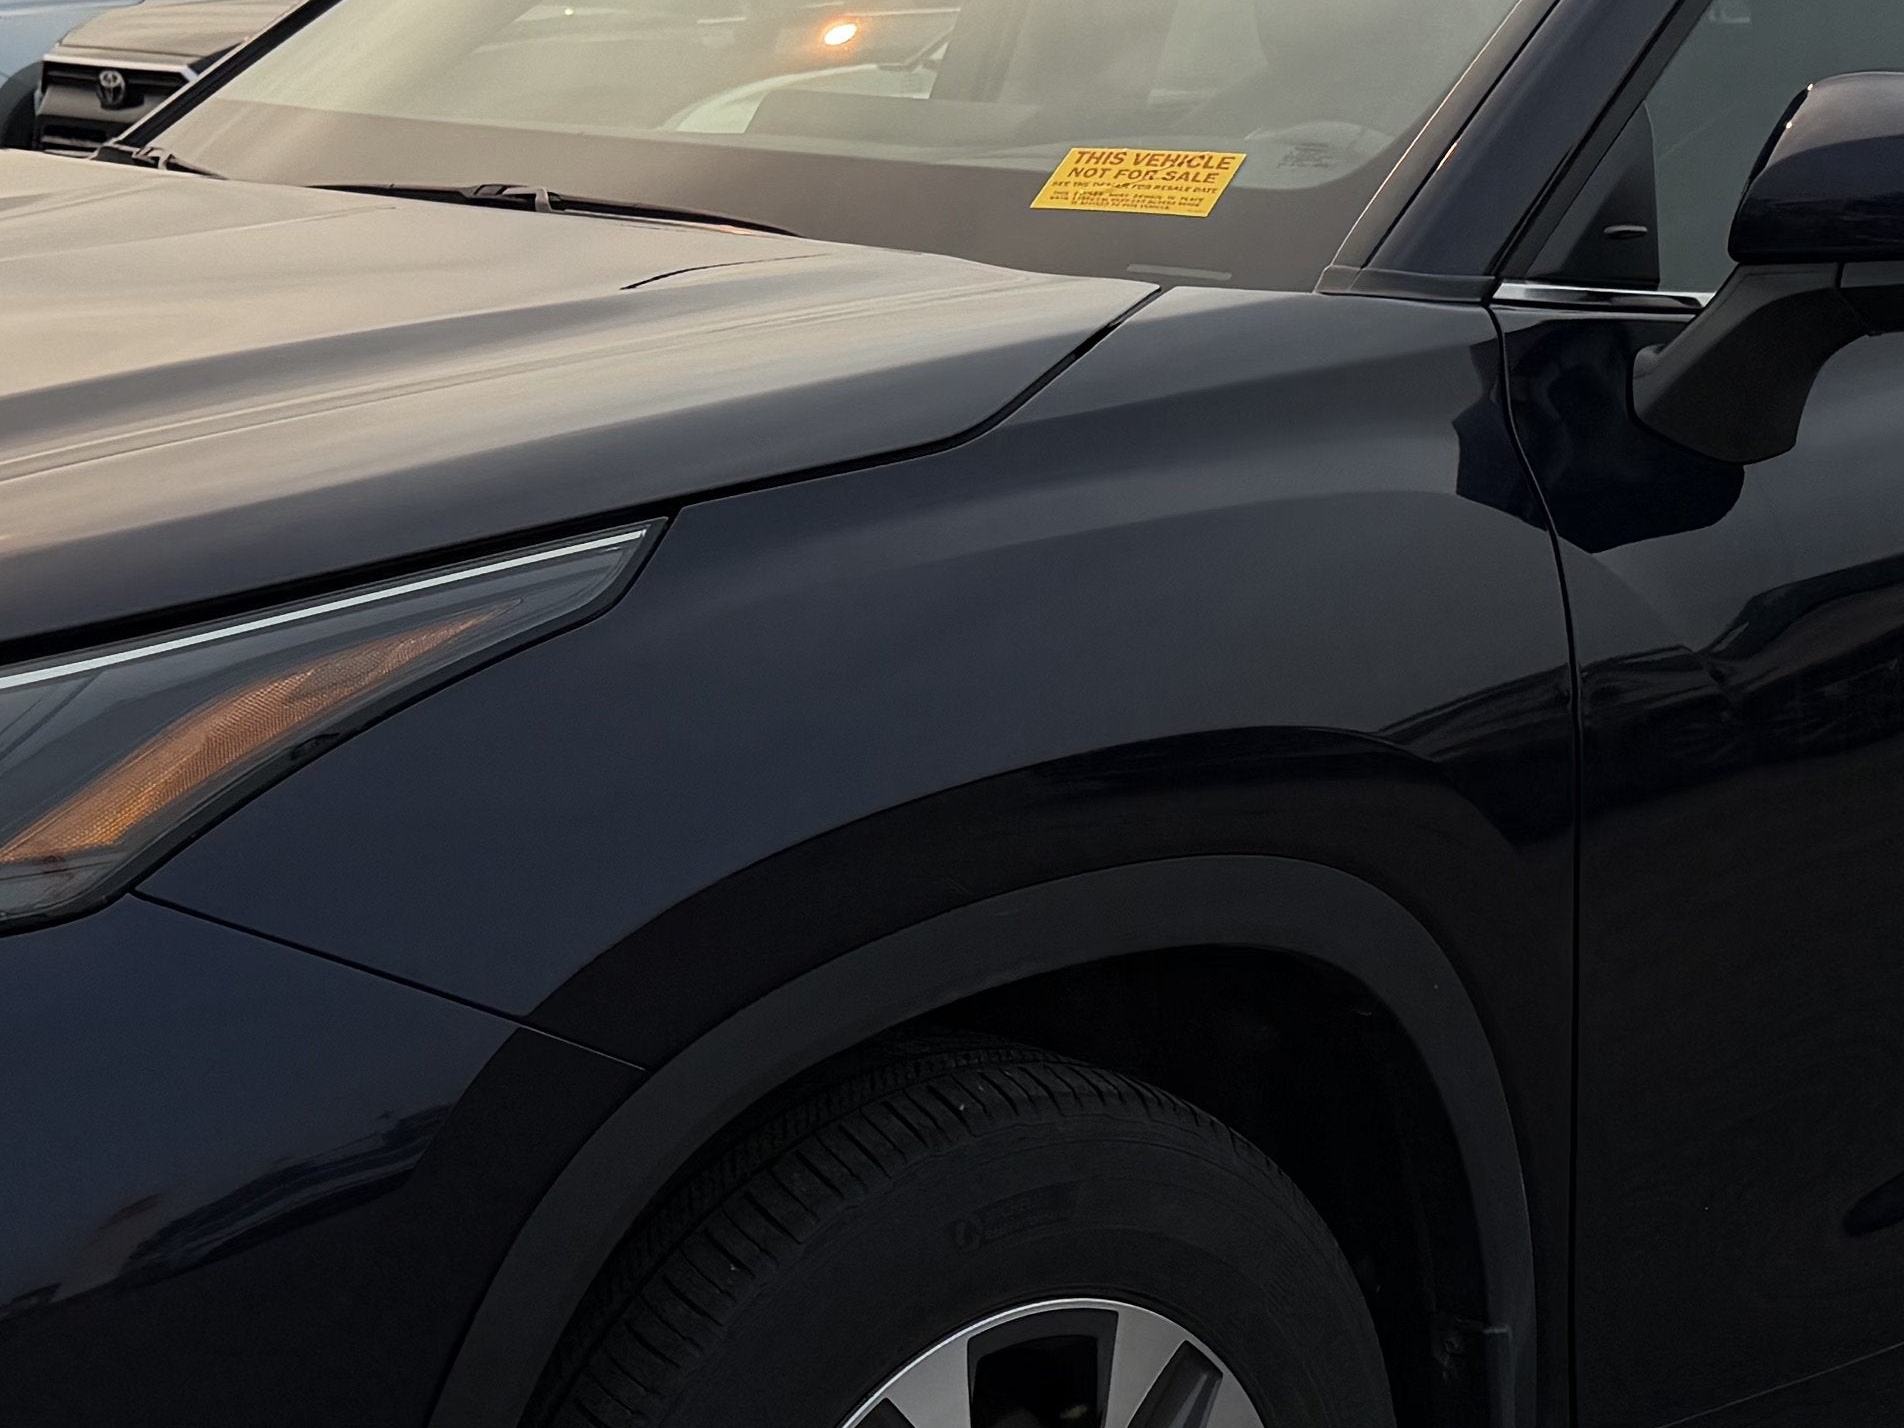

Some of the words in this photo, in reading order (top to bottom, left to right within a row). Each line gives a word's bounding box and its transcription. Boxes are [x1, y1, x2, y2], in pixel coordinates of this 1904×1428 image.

[1074, 151, 1127, 165] THIS
[1133, 153, 1236, 170] VEHICLE
[1067, 167, 1112, 178] NOT
[1113, 169, 1159, 180] FOR
[1161, 170, 1219, 183] SALE
